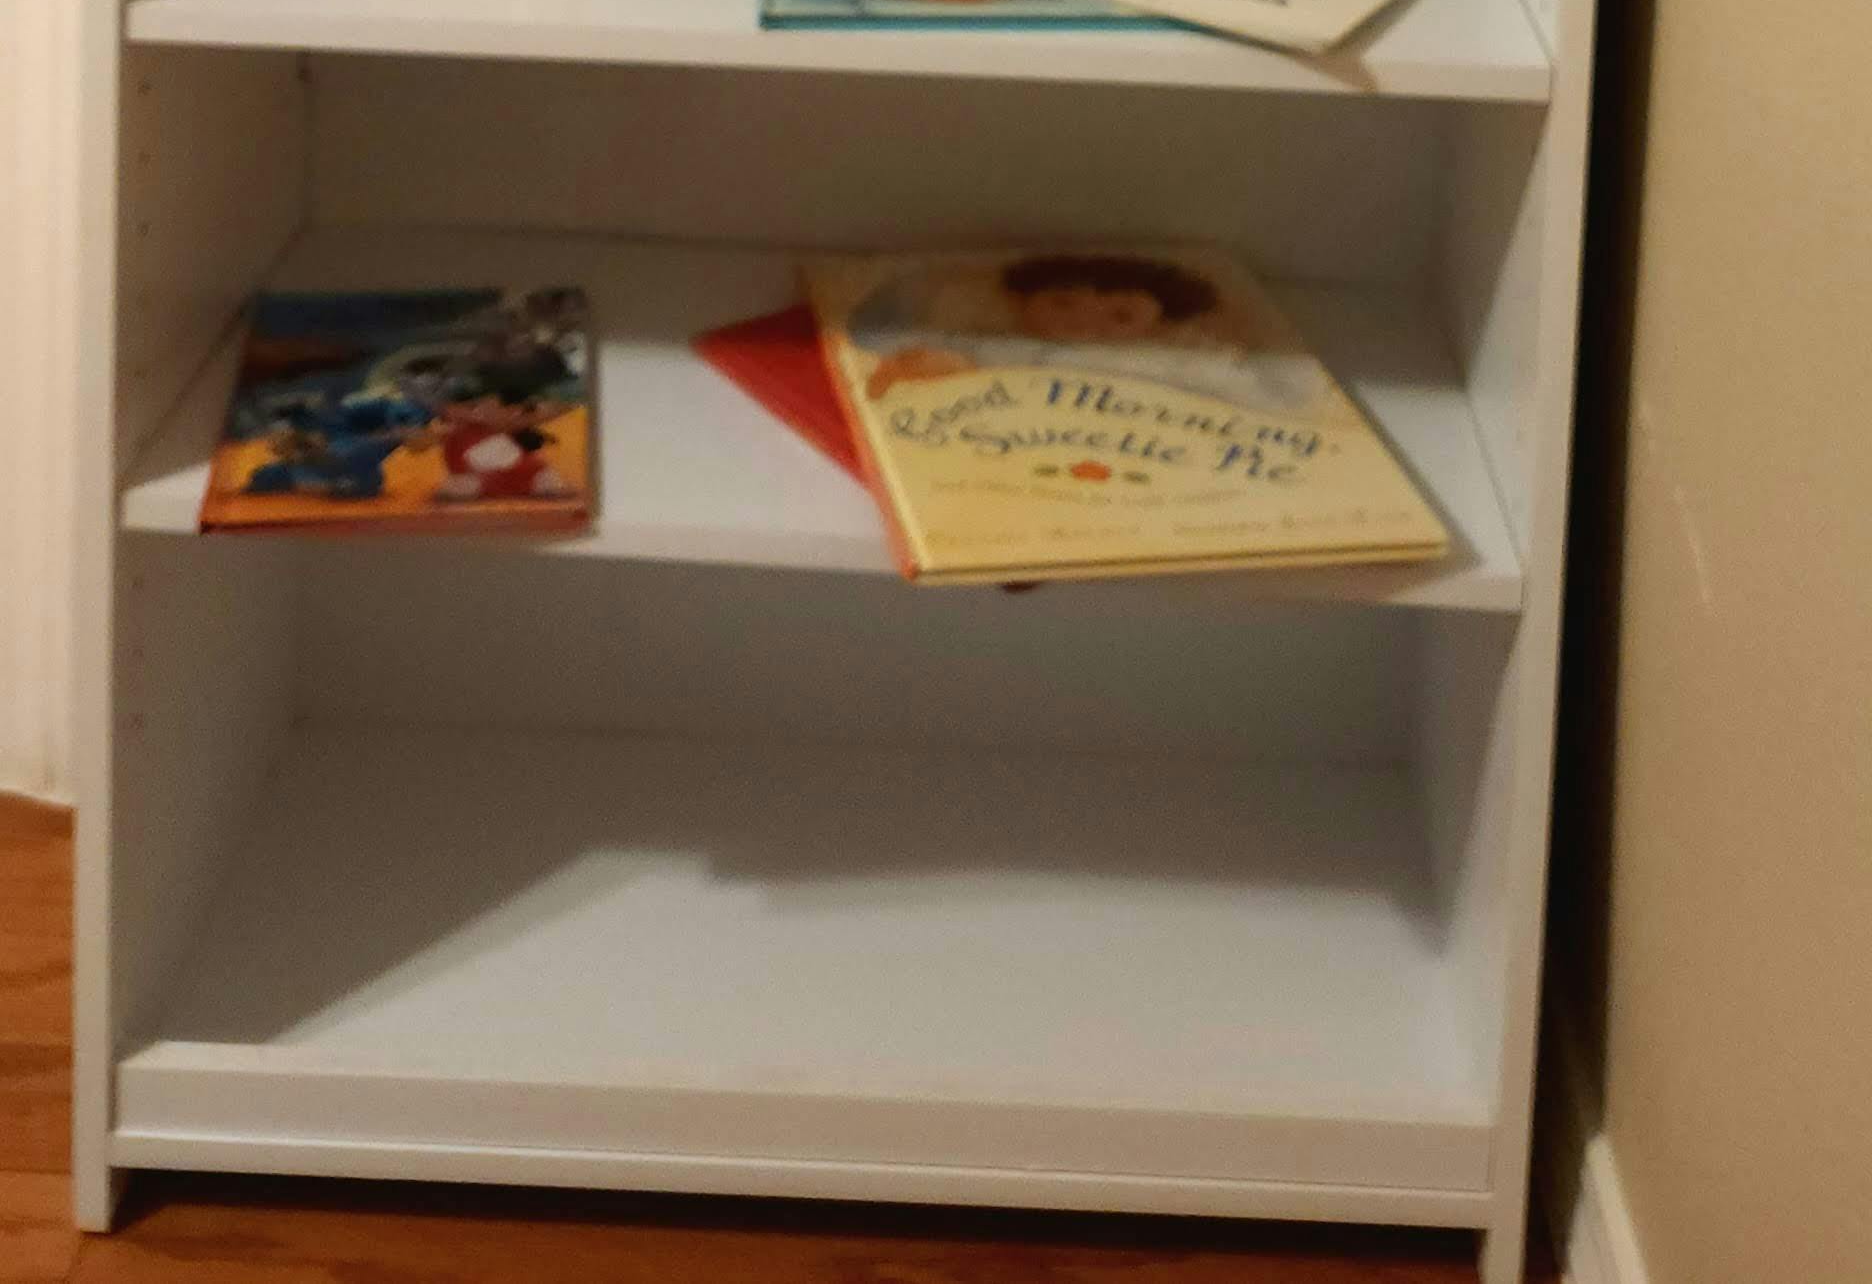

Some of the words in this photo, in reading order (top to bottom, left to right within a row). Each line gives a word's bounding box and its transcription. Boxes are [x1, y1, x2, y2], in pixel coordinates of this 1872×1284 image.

[888, 379, 1020, 448] Good
[958, 423, 1186, 466] Sweetie
[1213, 441, 1304, 484] Pie
